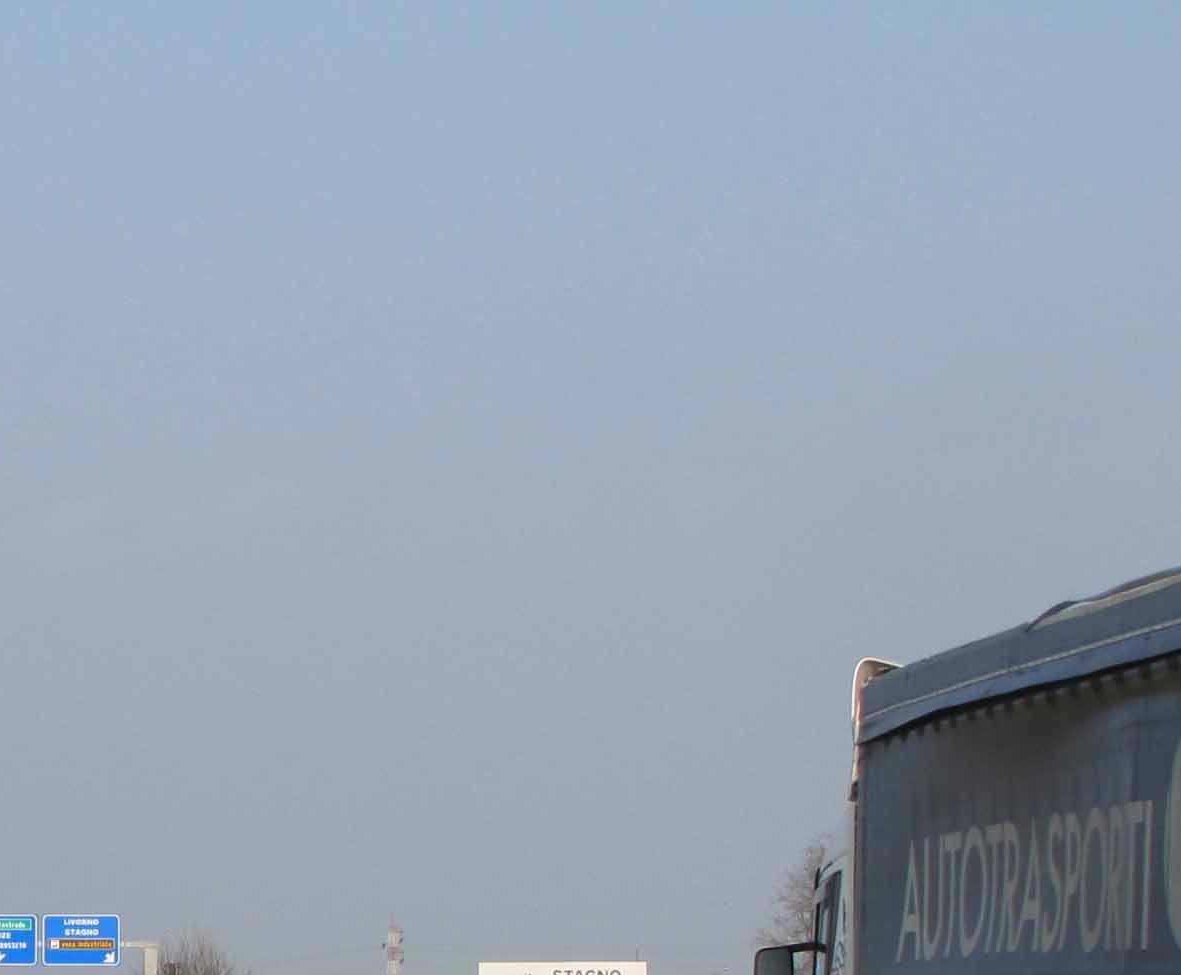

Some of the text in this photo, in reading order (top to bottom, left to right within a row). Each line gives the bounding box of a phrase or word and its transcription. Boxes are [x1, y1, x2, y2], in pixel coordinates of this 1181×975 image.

[895, 800, 1154, 964] AUTOTRASPORTI
[63, 918, 100, 926] LIVORNO
[64, 928, 100, 936] STAGNO
